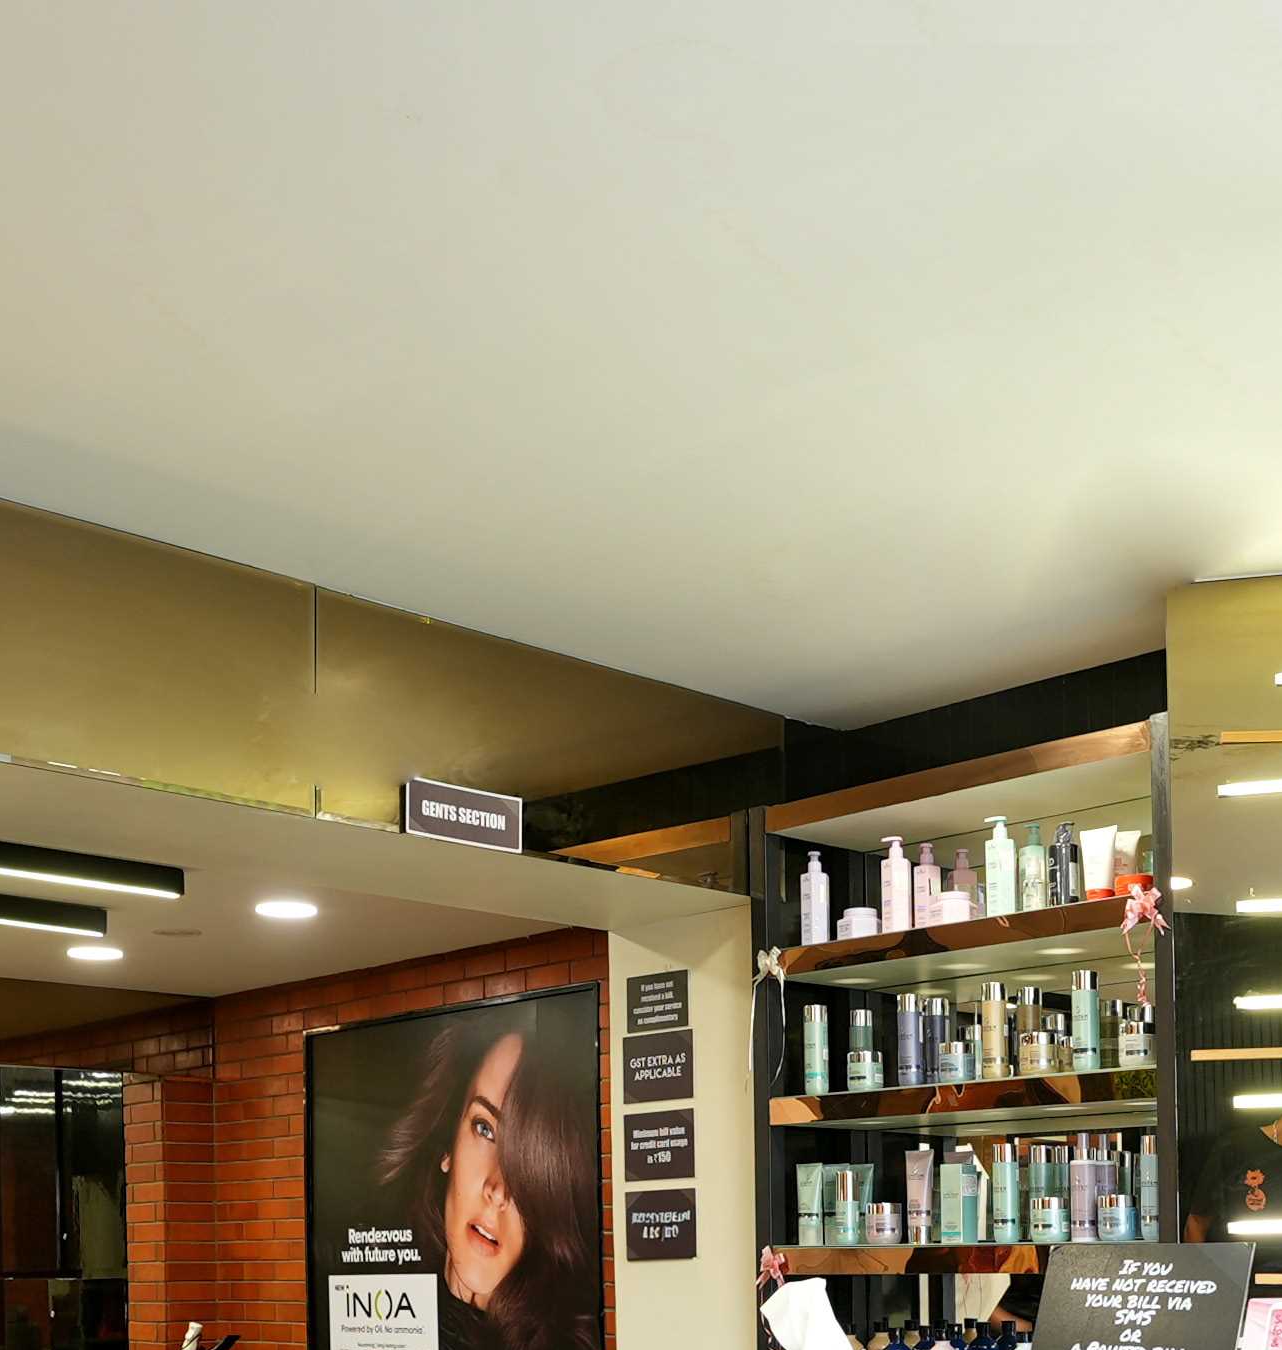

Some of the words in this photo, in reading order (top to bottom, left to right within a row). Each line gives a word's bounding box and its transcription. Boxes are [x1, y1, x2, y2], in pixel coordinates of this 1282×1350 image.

[421, 800, 457, 822] GENTS
[459, 807, 506, 831] SECTION
[630, 1057, 646, 1069] GST
[647, 1054, 673, 1067] EXTRA
[675, 1052, 686, 1063] AS
[634, 1066, 682, 1081] APPLICABLE
[348, 1227, 413, 1244] Rendezvous
[341, 1247, 364, 1263] with
[364, 1246, 396, 1262] future
[397, 1248, 422, 1265] you.
[1142, 1262, 1174, 1276] YOU
[1071, 1277, 1110, 1291] HAVE
[1112, 1278, 1145, 1292] NOT
[1146, 1279, 1217, 1294] RECEIVED
[1084, 1294, 1122, 1308] YOUR
[1126, 1295, 1161, 1309] BILL
[1167, 1297, 1193, 1311] VIA
[1114, 1309, 1156, 1326] SMS
[1119, 1328, 1142, 1343] OR
[1271, 1338, 1279, 1347] &
